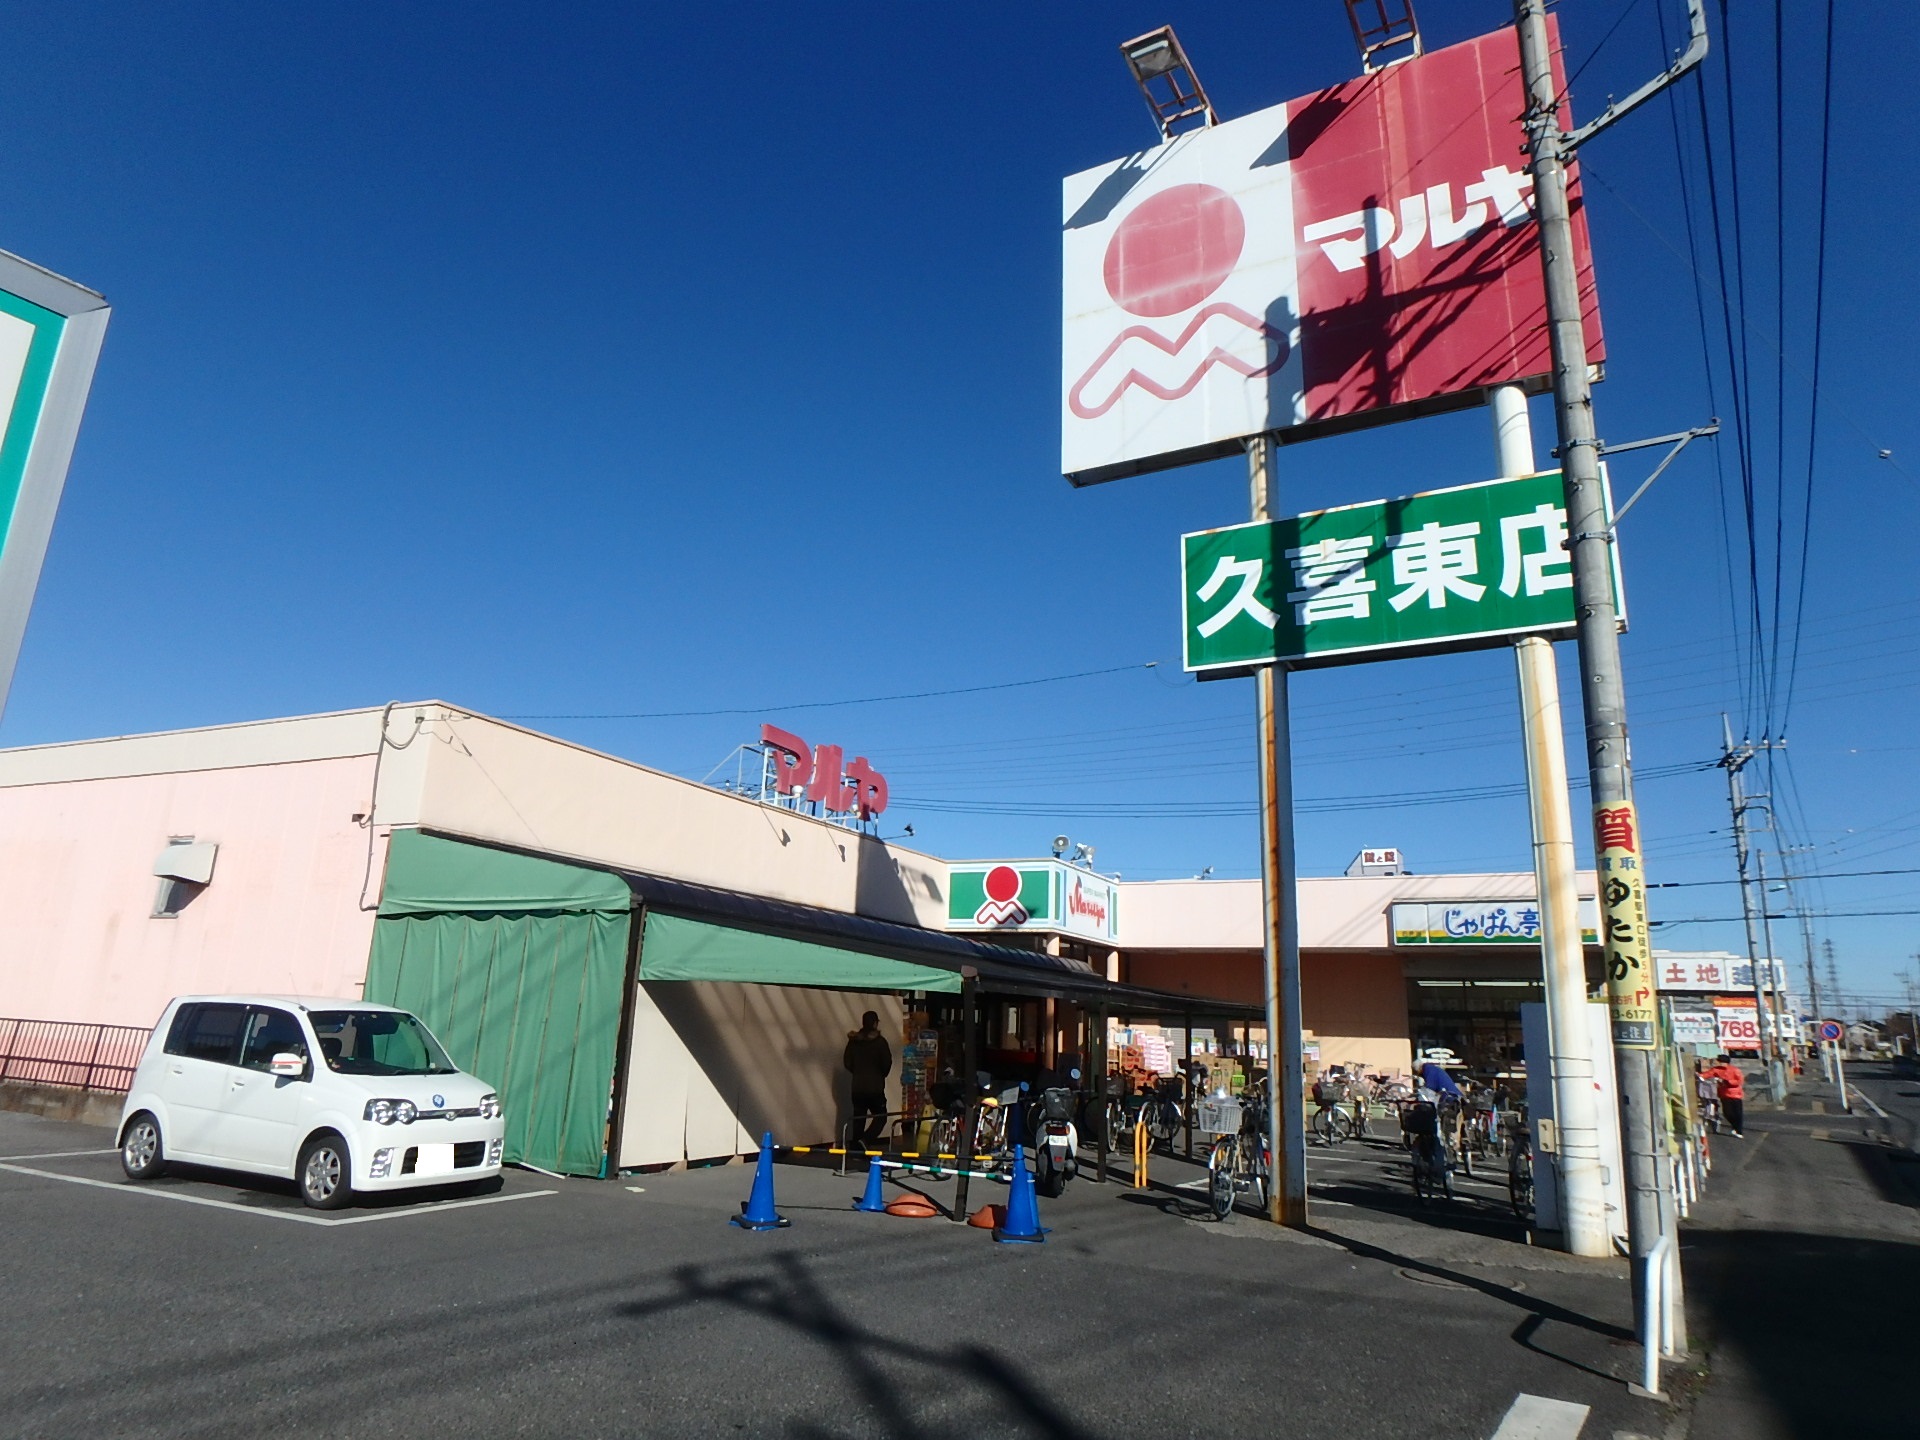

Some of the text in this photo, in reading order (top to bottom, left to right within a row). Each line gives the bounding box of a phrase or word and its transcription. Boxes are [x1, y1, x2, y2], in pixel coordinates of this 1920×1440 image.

[1303, 165, 1536, 272] マルヤ
[1196, 503, 1574, 639] 久喜東店
[1445, 908, 1539, 937] じゃぱん亭
[1602, 876, 1640, 981] ゆたか
[1666, 963, 1721, 983] 土地
[1720, 1021, 1756, 1038] 768
